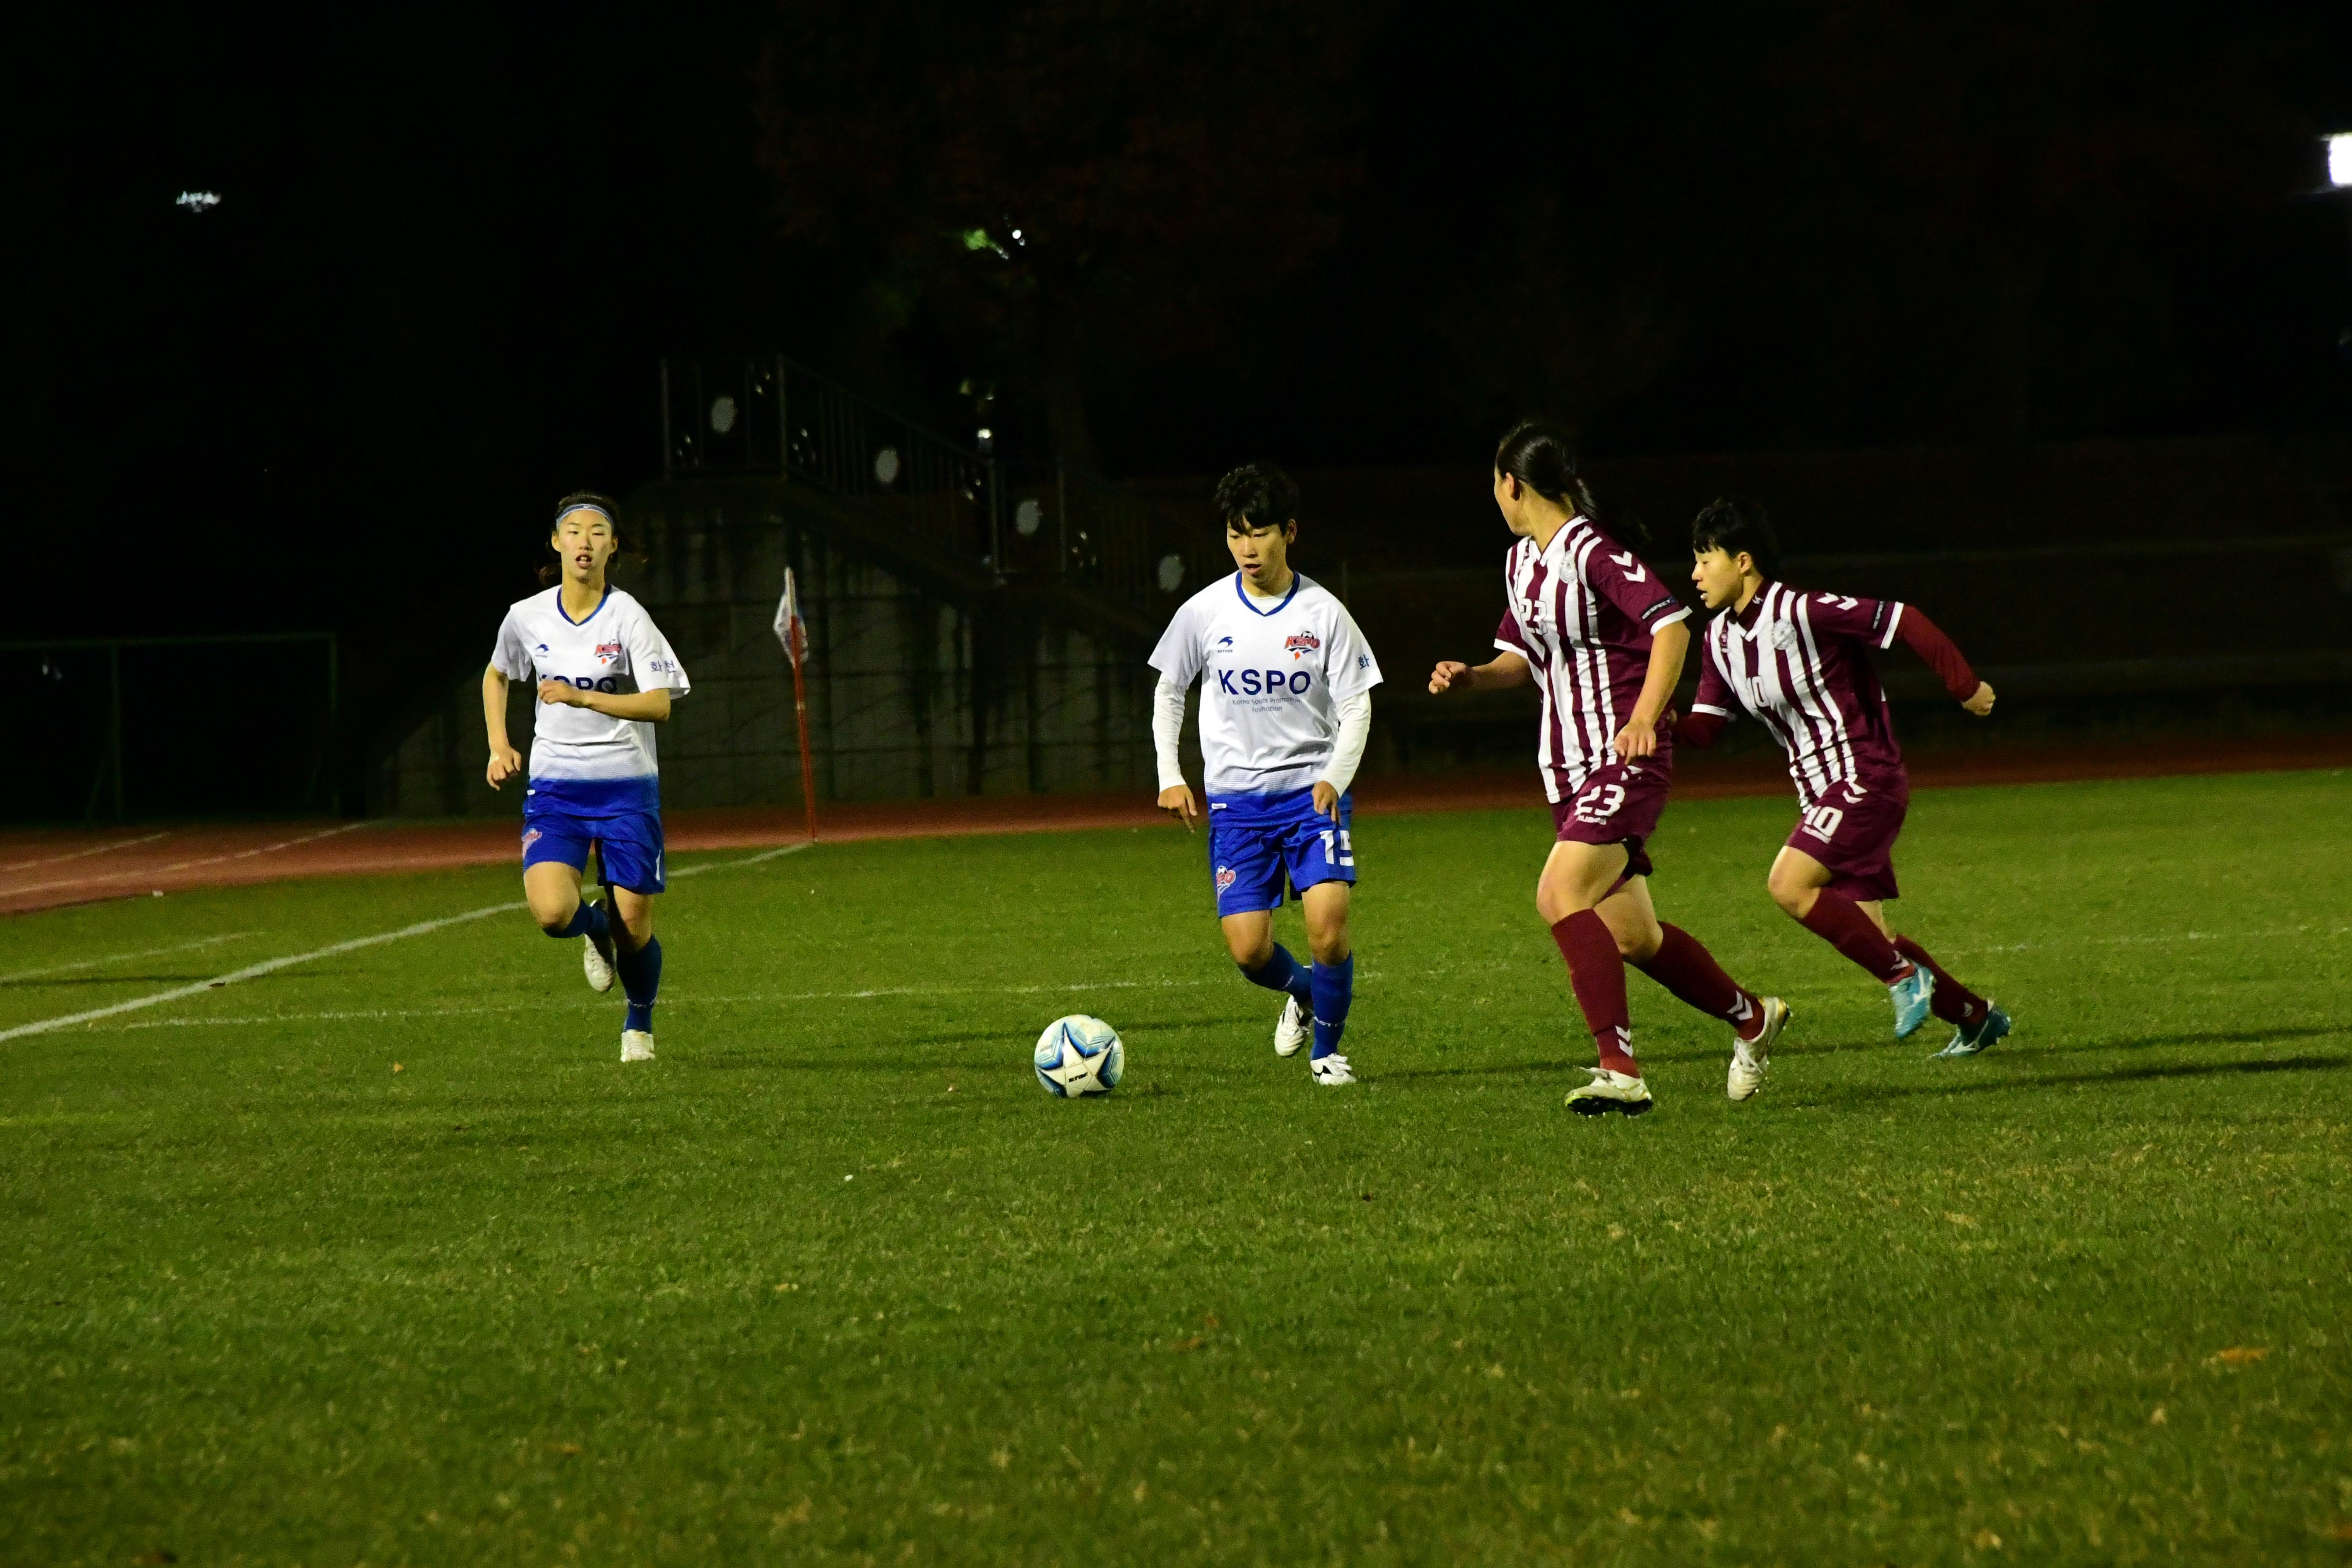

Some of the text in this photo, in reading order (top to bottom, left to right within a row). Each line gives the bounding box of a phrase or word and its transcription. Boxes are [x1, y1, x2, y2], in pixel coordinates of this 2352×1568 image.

[1520, 597, 1548, 635] 23
[539, 674, 617, 693] PO
[1218, 669, 1311, 695] KSPO
[1745, 675, 1771, 710] 10
[1574, 784, 1625, 817] 23
[1804, 806, 1843, 837] 10
